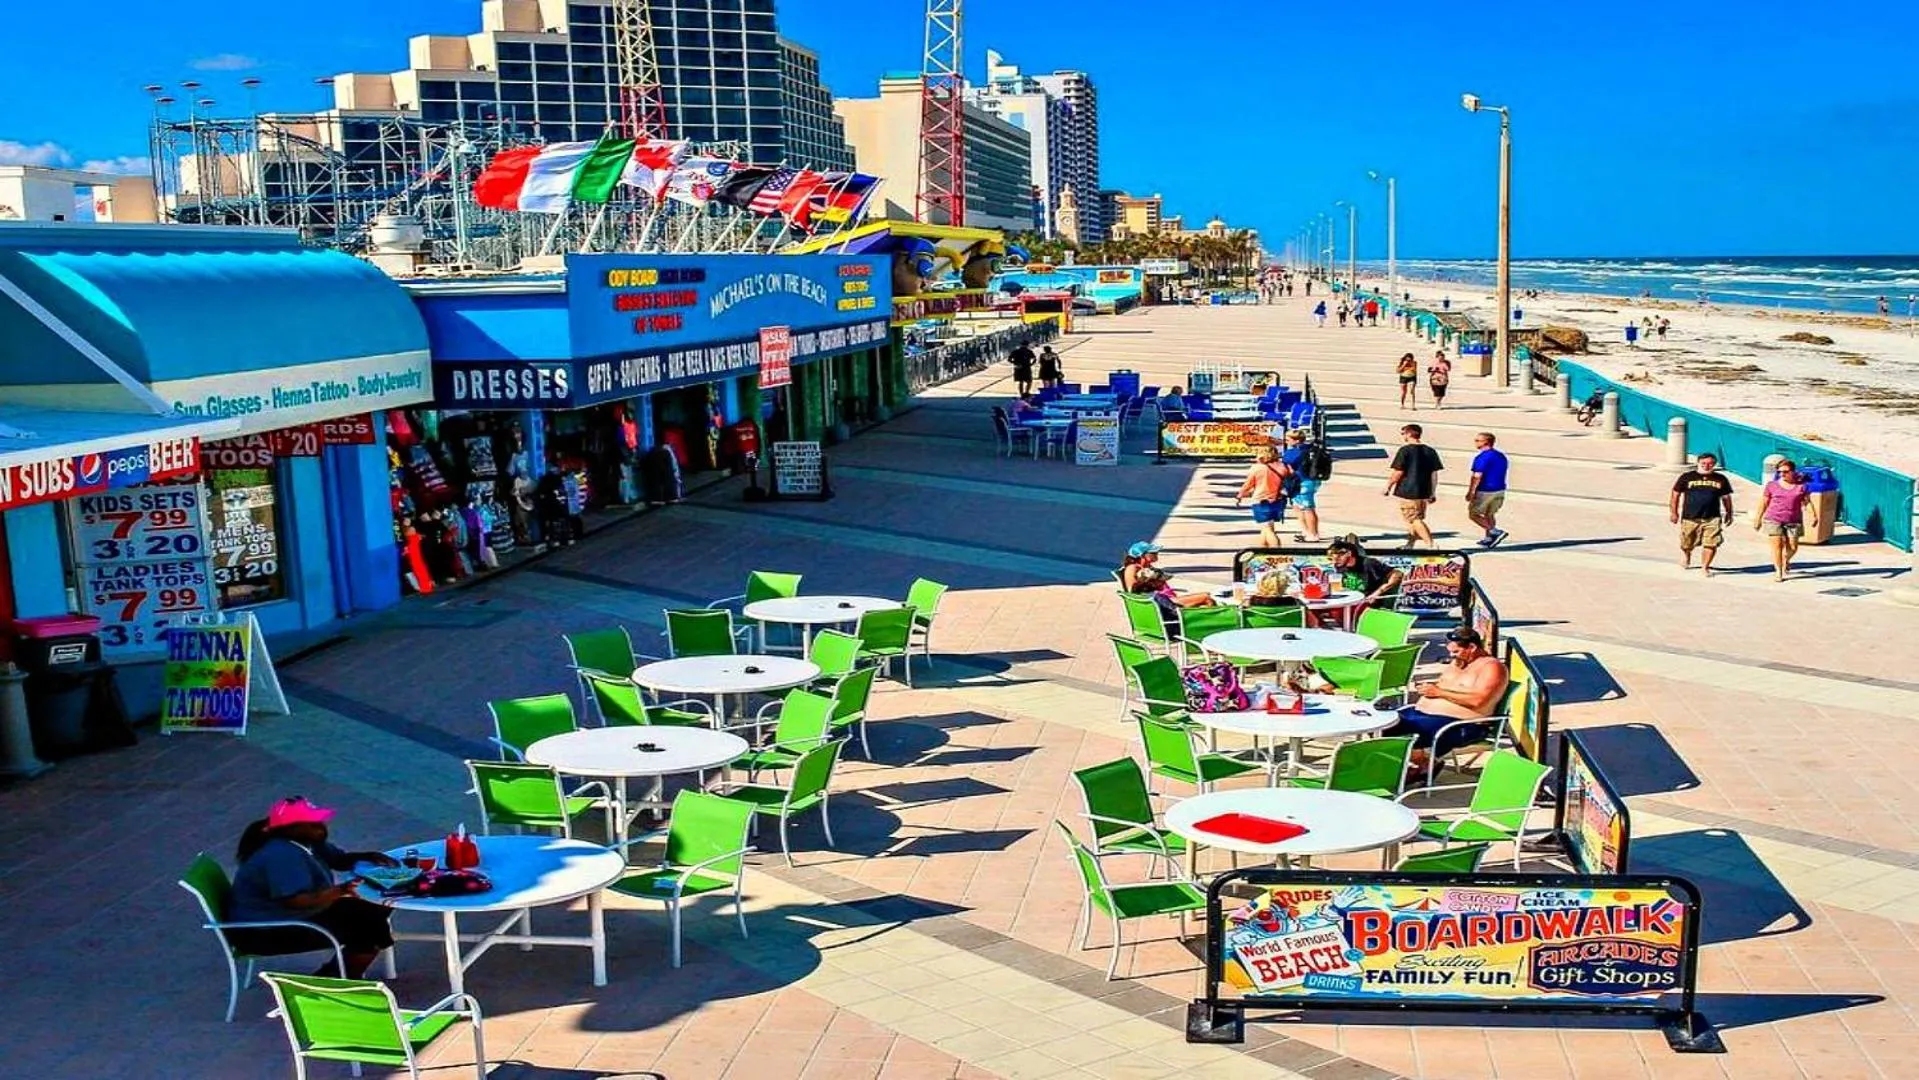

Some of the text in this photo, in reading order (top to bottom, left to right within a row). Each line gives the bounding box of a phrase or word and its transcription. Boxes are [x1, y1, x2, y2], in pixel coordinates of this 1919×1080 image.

[709, 273, 764, 319] MICHAEL'S
[766, 273, 782, 293] ON
[784, 273, 800, 294] THE
[801, 276, 828, 307] BEACH
[453, 368, 569, 400] DRESSES
[588, 362, 612, 394] GIFTS
[207, 395, 262, 417] Glasses
[272, 386, 311, 409] Henna
[311, 381, 349, 402] Tattoo
[1167, 424, 1200, 433] BEST
[1177, 434, 1195, 443] ON
[1199, 434, 1223, 443] THE
[19, 458, 76, 499] SUBS
[108, 450, 149, 478] pepsi
[149, 438, 195, 474] BEER
[79, 491, 196, 514] KIDS SETS
[210, 531, 276, 549] TANK TOPS
[217, 524, 267, 539] MENS
[93, 540, 120, 559] 3
[145, 534, 199, 555] 20
[89, 572, 206, 592] TANK TOPS
[96, 561, 196, 580] LADIES
[214, 568, 231, 583] 3
[244, 560, 278, 579] 20
[1403, 583, 1460, 596] RCADES
[102, 625, 128, 647] 3
[169, 630, 246, 662] HENNA
[166, 686, 244, 718] TATTOOS
[1273, 889, 1333, 906] RIDES
[1521, 898, 1580, 907] CREAM
[1536, 890, 1566, 898] ICE
[1348, 898, 1679, 957] BOARDWALK
[1239, 930, 1339, 958] World Famous
[1538, 942, 1680, 967] ARCADES
[1251, 944, 1351, 984] BEACH
[1394, 952, 1488, 971] Exciting
[1539, 965, 1675, 988] Gift Shops
